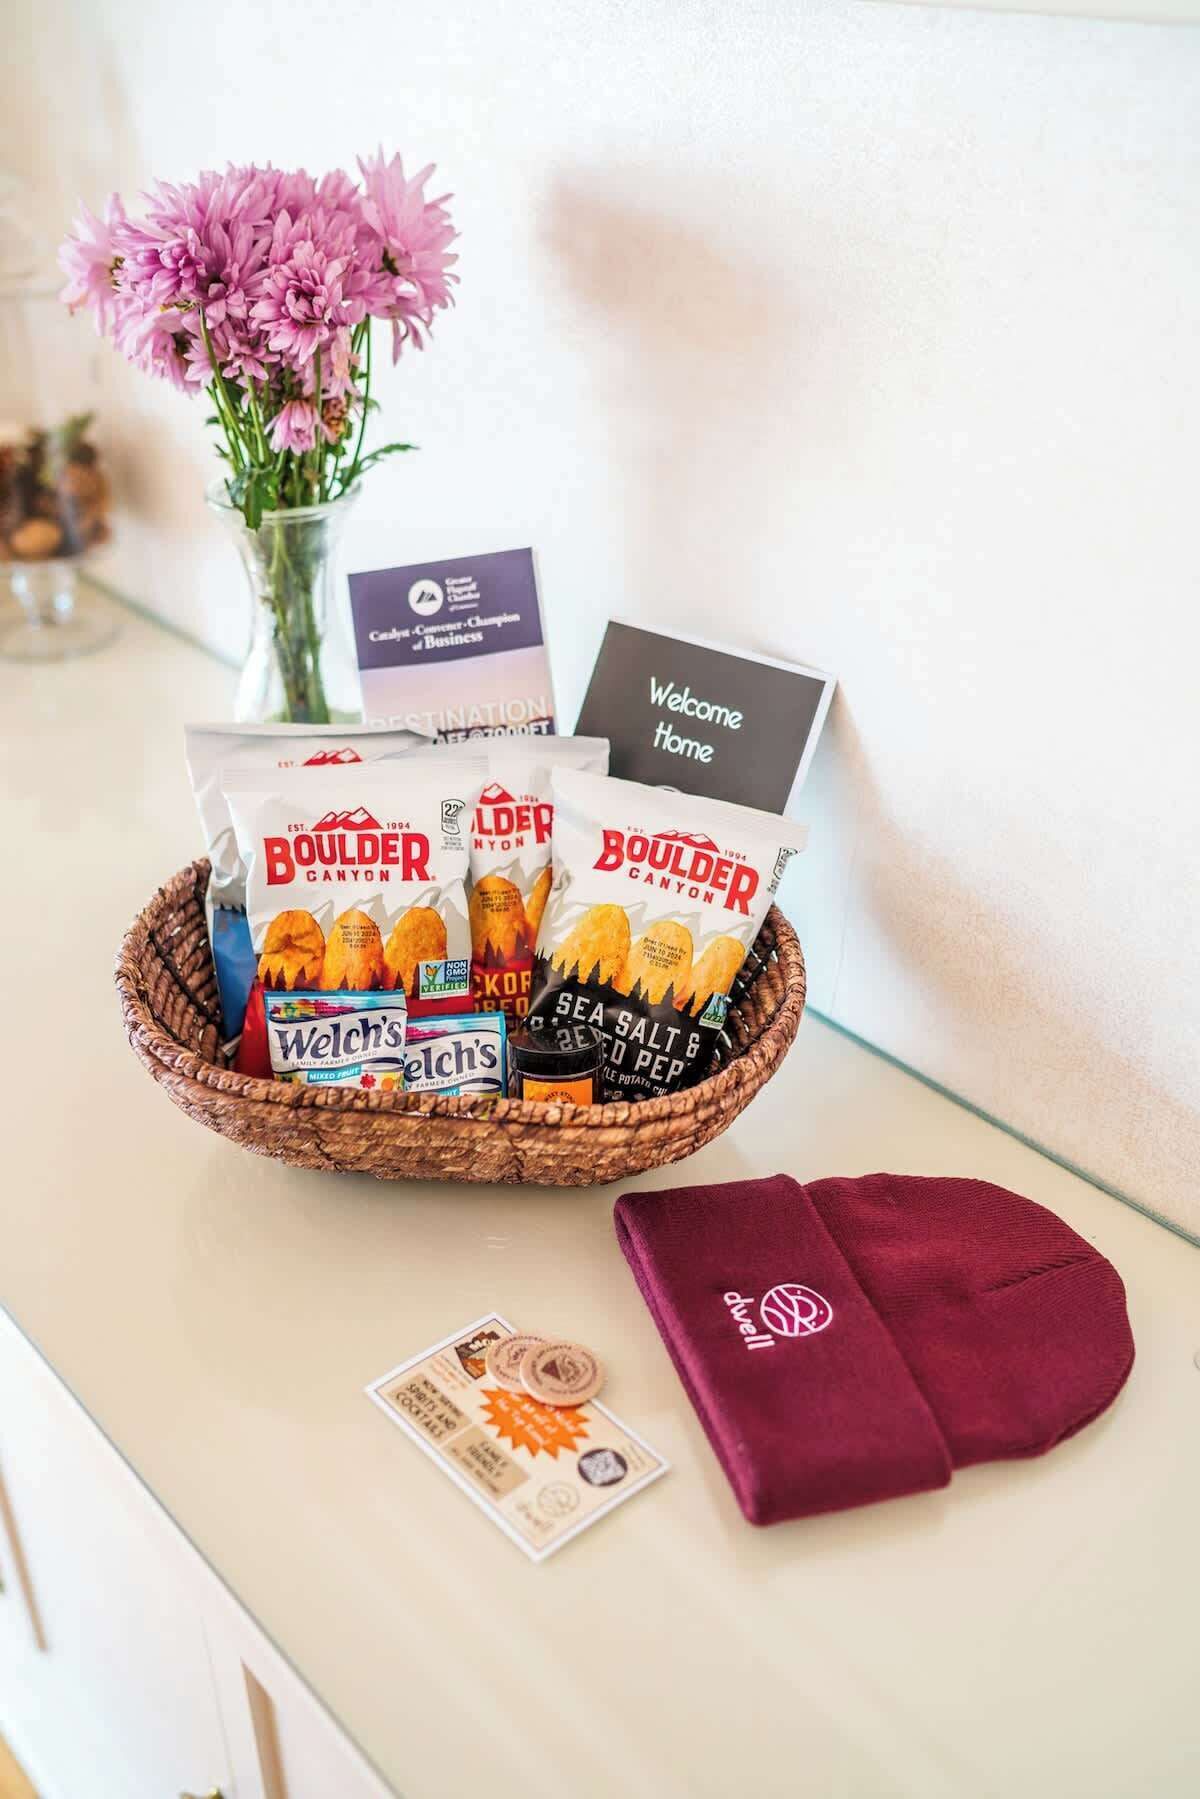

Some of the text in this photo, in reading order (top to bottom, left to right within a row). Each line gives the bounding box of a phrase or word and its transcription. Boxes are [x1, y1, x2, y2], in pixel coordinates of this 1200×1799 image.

[368, 627, 411, 643] Catalyst
[466, 611, 521, 628] Champion
[423, 630, 484, 650] Business
[649, 676, 744, 730] Welcome
[653, 720, 715, 764] Home
[287, 821, 411, 833] EST. 1994
[471, 802, 555, 844] LDER
[263, 832, 430, 886] BOULDER
[474, 836, 525, 851] NYON
[724, 849, 748, 863] 1994
[306, 869, 391, 882] CANYON
[592, 829, 760, 917] BOULDER
[628, 866, 716, 905] CANYON
[446, 961, 467, 969] NON
[446, 968, 467, 976] GMO
[423, 981, 467, 993] VERIFIED
[474, 970, 532, 998] CKOR
[274, 1015, 404, 1062] Welch's
[555, 992, 604, 1027] SEA
[614, 1010, 682, 1053] SALT
[685, 1031, 700, 1059] &
[309, 1067, 360, 1082] MIXED FRUIT
[403, 1038, 497, 1083] elch's
[633, 1048, 688, 1084] PEP
[416, 1080, 446, 1089] FARMER
[447, 1072, 475, 1085] OWNED
[618, 1073, 652, 1088] POTATO
[723, 1291, 776, 1351] dwell
[395, 1391, 446, 1439] COCKTAILS
[407, 1383, 438, 1412] SPIRITS
[436, 1412, 456, 1431] AND
